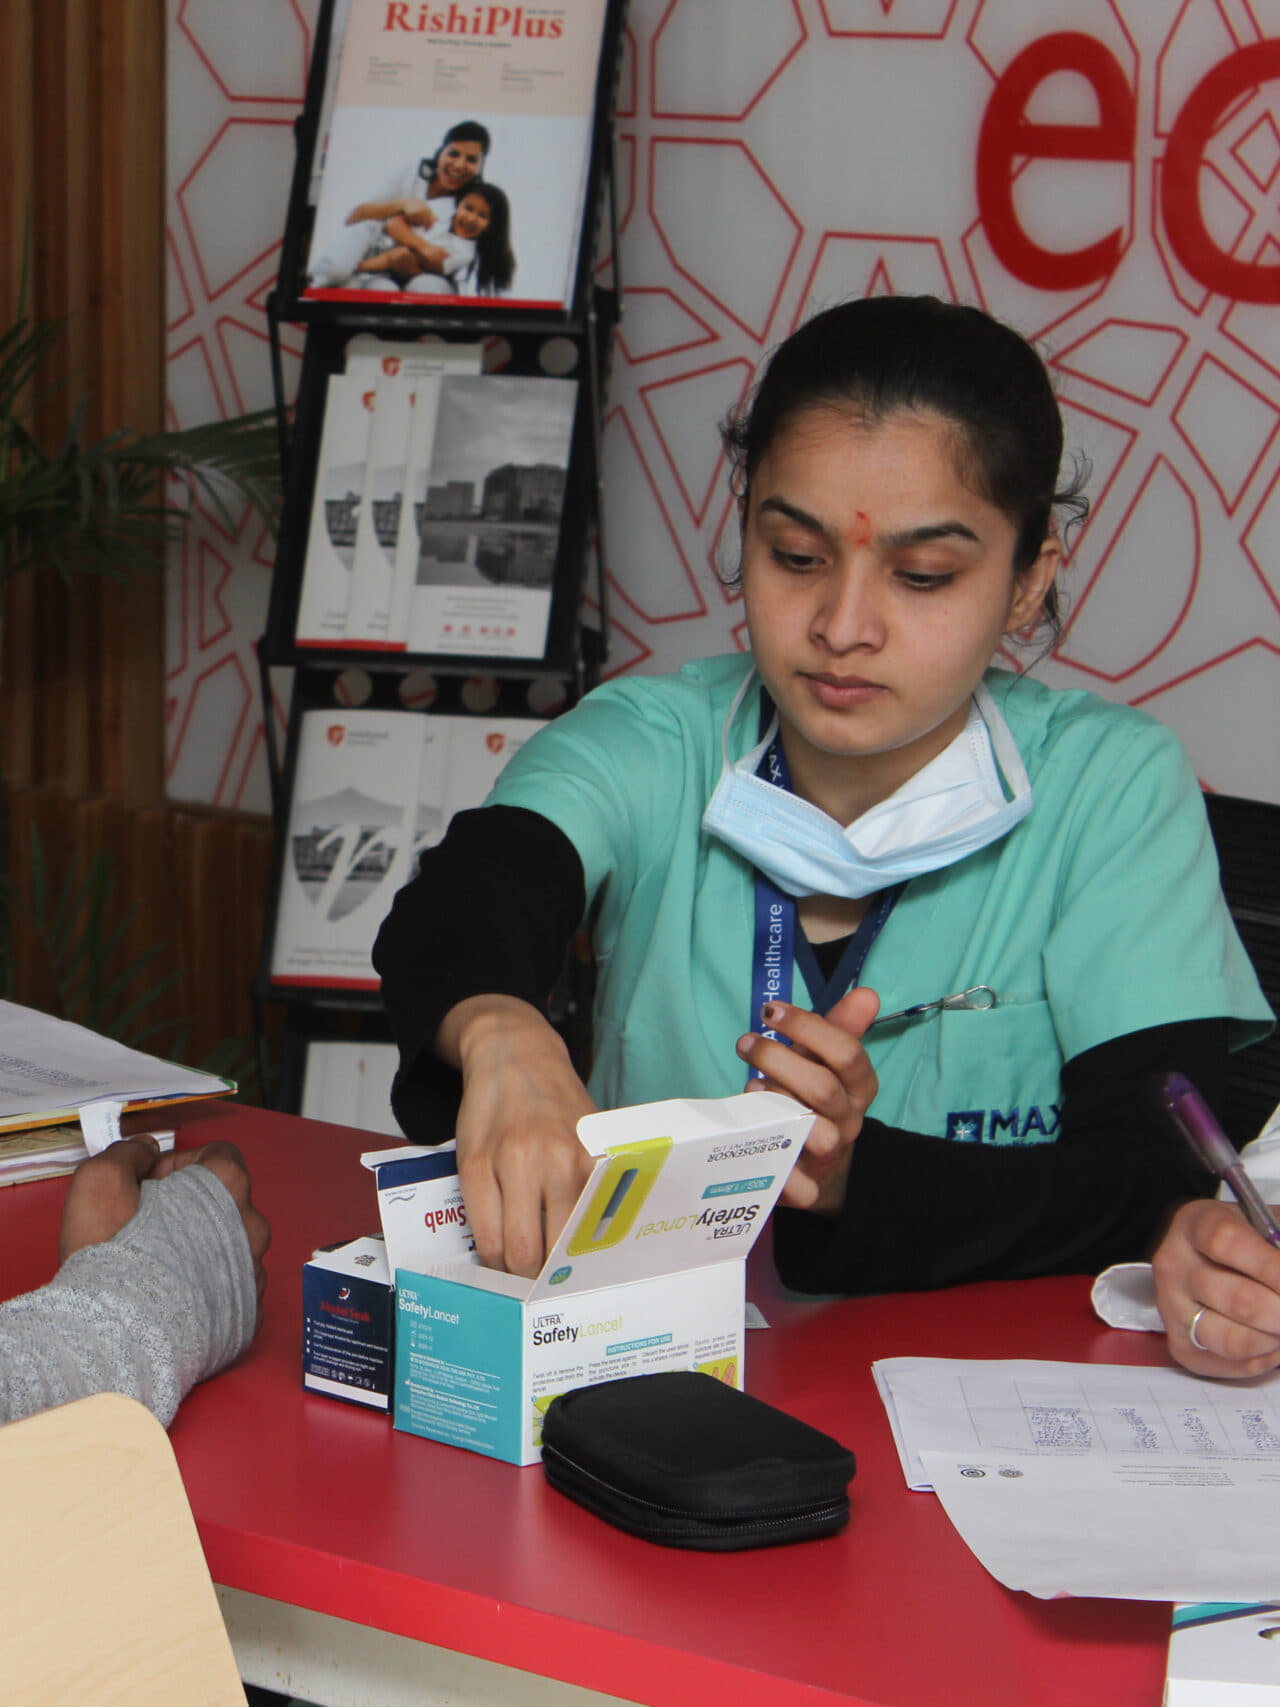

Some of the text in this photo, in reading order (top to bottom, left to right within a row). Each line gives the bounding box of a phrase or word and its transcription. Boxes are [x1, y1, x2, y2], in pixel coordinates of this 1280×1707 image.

[383, 1, 565, 39] RishiPlus
[763, 903, 783, 1003] Healthcare
[707, 1143, 768, 1163] BIOSENSOR
[424, 1205, 467, 1233] Swab
